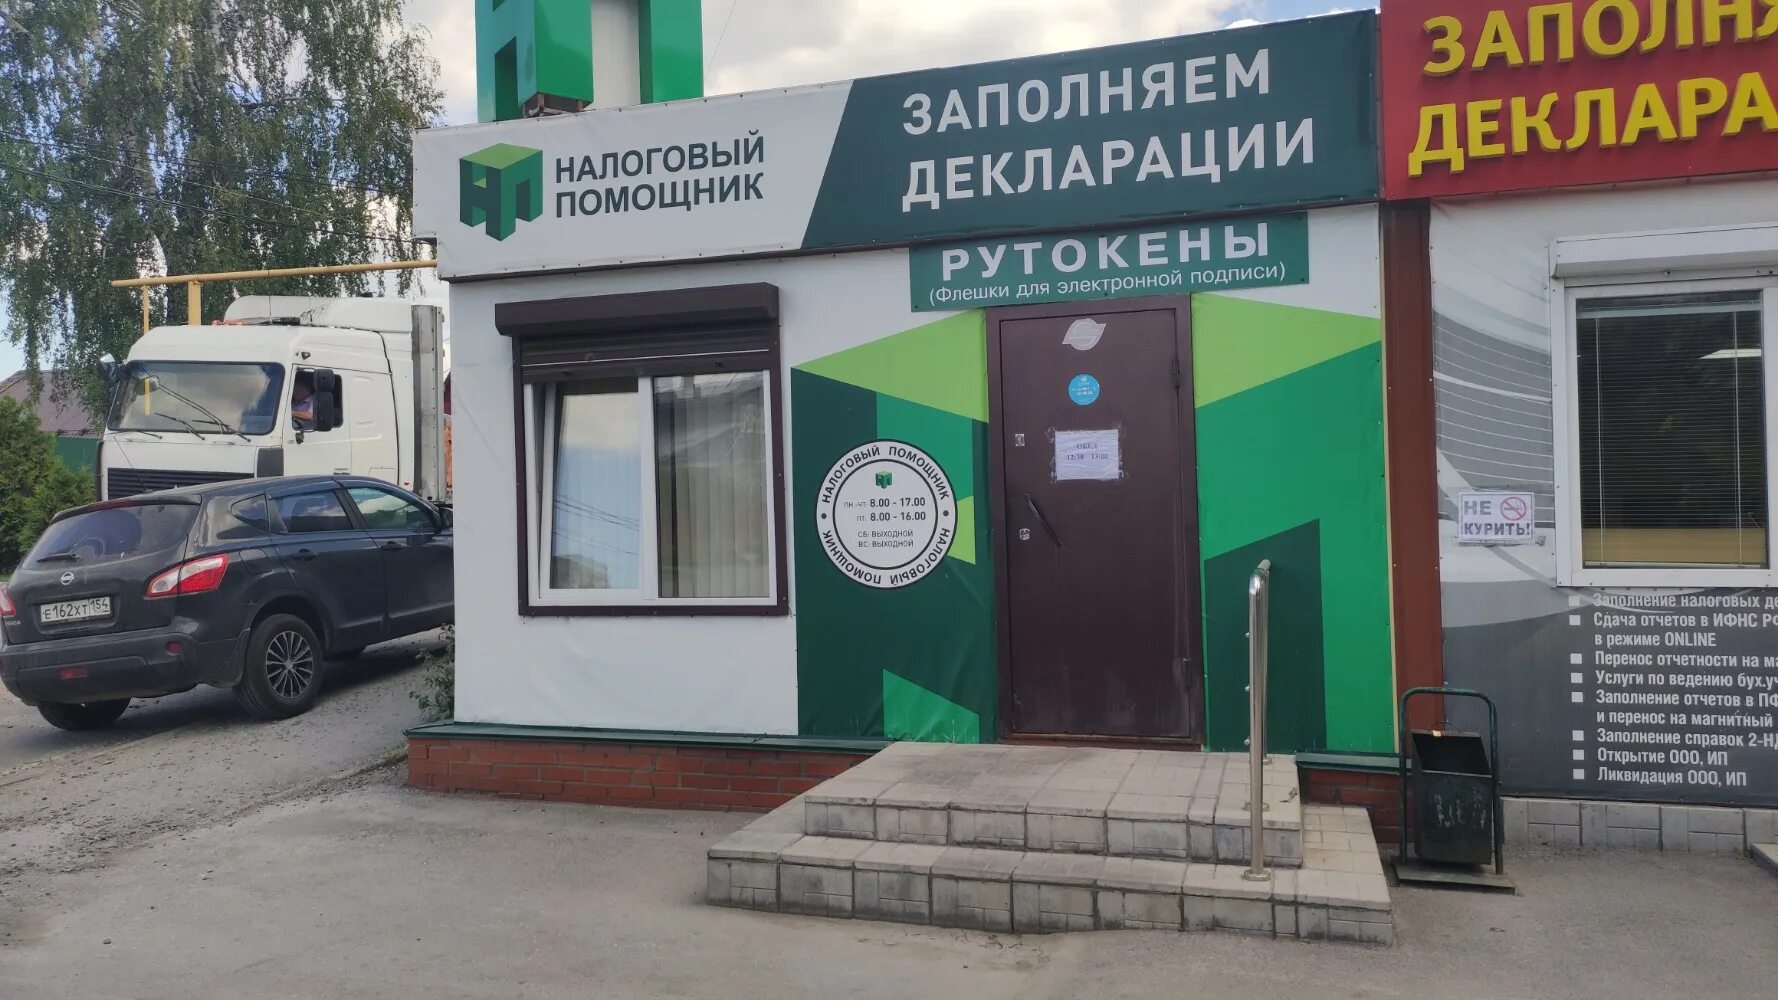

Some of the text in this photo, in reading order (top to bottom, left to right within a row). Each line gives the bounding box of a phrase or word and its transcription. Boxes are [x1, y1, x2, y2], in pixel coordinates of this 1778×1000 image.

[903, 49, 1270, 135] ЗАПОЛНЯЕМ
[556, 130, 764, 183] НАЛОГОВЫЙ
[902, 118, 1314, 212] ДЕКЛАРАЦИИ
[556, 172, 764, 218] ПОМОЩНИК
[942, 223, 1268, 281] РУТОКЕНЫ
[929, 261, 1286, 306] (Флешки для электронной подписи)
[822, 445, 949, 503] НАЛОГОВЫЙ ПОМОЩНИК
[869, 498, 890, 508] 8.00
[900, 497, 926, 507] 17.00
[1463, 500, 1492, 515] НЕ
[870, 512, 891, 521] 8.00
[900, 511, 926, 521] 16.00
[871, 529, 914, 538] ВЫХОДНОЙ
[1464, 522, 1530, 536] КУРИТЬ!
[872, 539, 914, 548] ВЫХОДНОЙ
[822, 528, 951, 585] НАЛОГОВЫЙ ПОМОЩНИК
[1593, 593, 1676, 607] Заполнение
[1681, 595, 1760, 608] налоговых
[1593, 611, 1636, 628] Сдача
[1640, 615, 1696, 627] отчетов
[1700, 615, 1709, 627] в
[1712, 612, 1758, 628] ИФНС
[1594, 631, 1717, 649] в режиме ONLINE
[1595, 651, 1653, 668] Перенос
[1657, 654, 1737, 668] отчетности
[1741, 656, 1760, 668] на
[1595, 670, 1644, 687] Услуги
[1648, 673, 1665, 685] по
[1669, 674, 1733, 688] ведению
[1596, 689, 1680, 705] Заполнение
[1683, 693, 1741, 707] отчетов
[1745, 695, 1754, 707] в
[1596, 711, 1773, 728] и перенос на магнитный
[1597, 728, 1681, 744] Заполнение
[1685, 733, 1744, 748] справок
[1597, 747, 1729, 766] Открытие ООО, ИП
[1597, 766, 1747, 787] Ликвидация ООО, ИП
